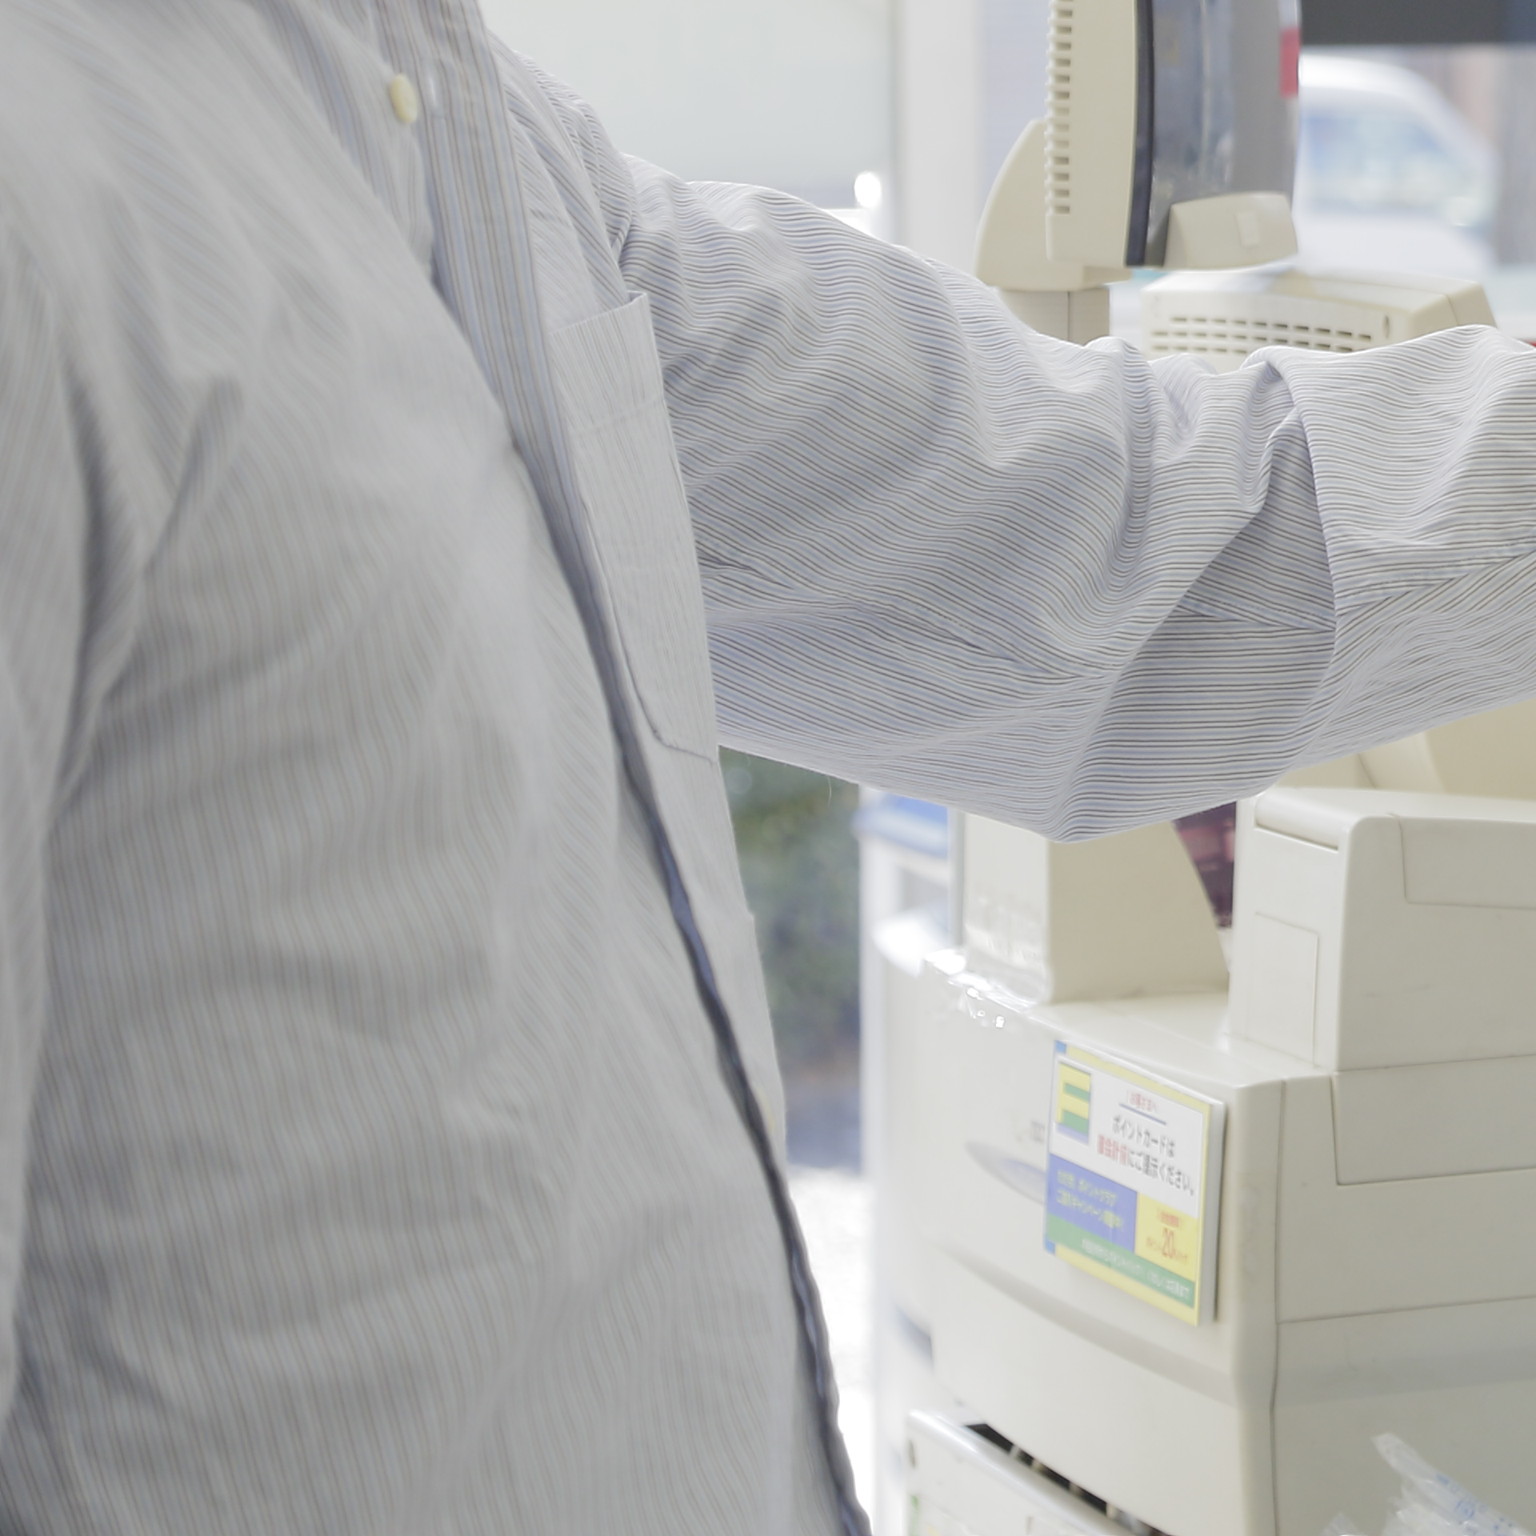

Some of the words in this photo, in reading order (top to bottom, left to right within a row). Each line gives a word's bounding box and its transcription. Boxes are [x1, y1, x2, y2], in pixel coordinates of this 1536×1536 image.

[1112, 1114, 1176, 1159] ポイントカードは
